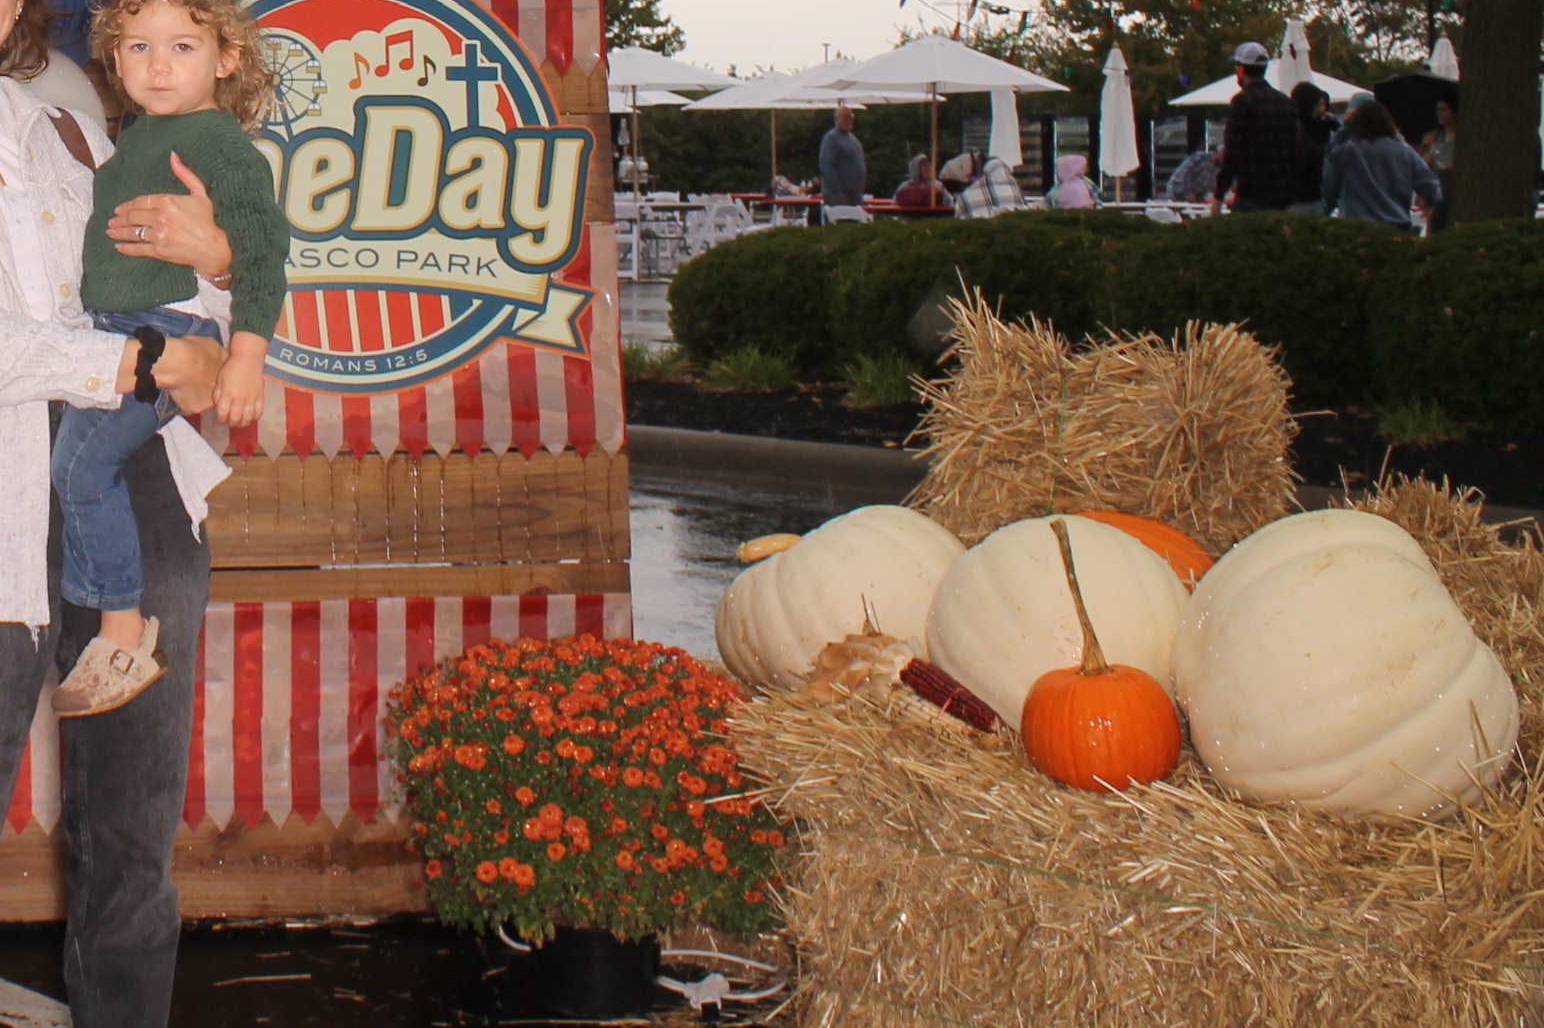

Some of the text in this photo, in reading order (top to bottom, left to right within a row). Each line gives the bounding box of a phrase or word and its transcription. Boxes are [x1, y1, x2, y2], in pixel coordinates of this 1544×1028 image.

[396, 249, 498, 279] PARK
[279, 348, 428, 372] ROMANS 12:5
